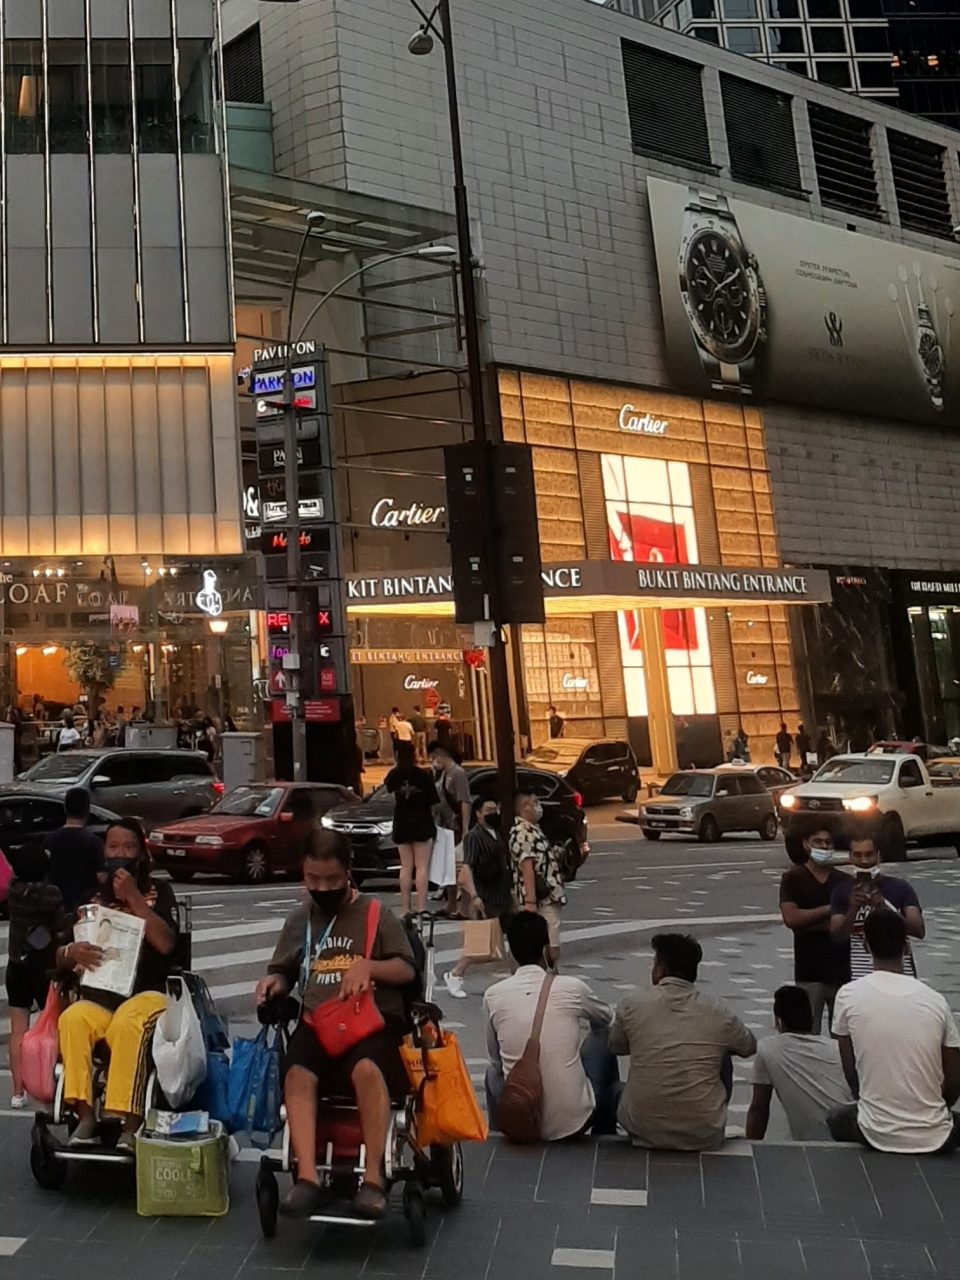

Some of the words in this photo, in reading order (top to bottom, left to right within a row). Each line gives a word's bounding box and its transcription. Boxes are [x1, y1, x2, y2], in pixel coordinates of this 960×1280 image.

[251, 370, 314, 393] PARKON
[619, 404, 668, 433] Cartier
[371, 498, 445, 527] Cartier
[383, 574, 454, 597] BINTAN
[639, 570, 678, 589] BUKIT
[683, 571, 741, 591] BINTANG
[744, 574, 808, 593] ENTRANCE
[404, 674, 439, 689] Cartier
[562, 672, 588, 689] Cartier
[746, 670, 768, 685] Cartier
